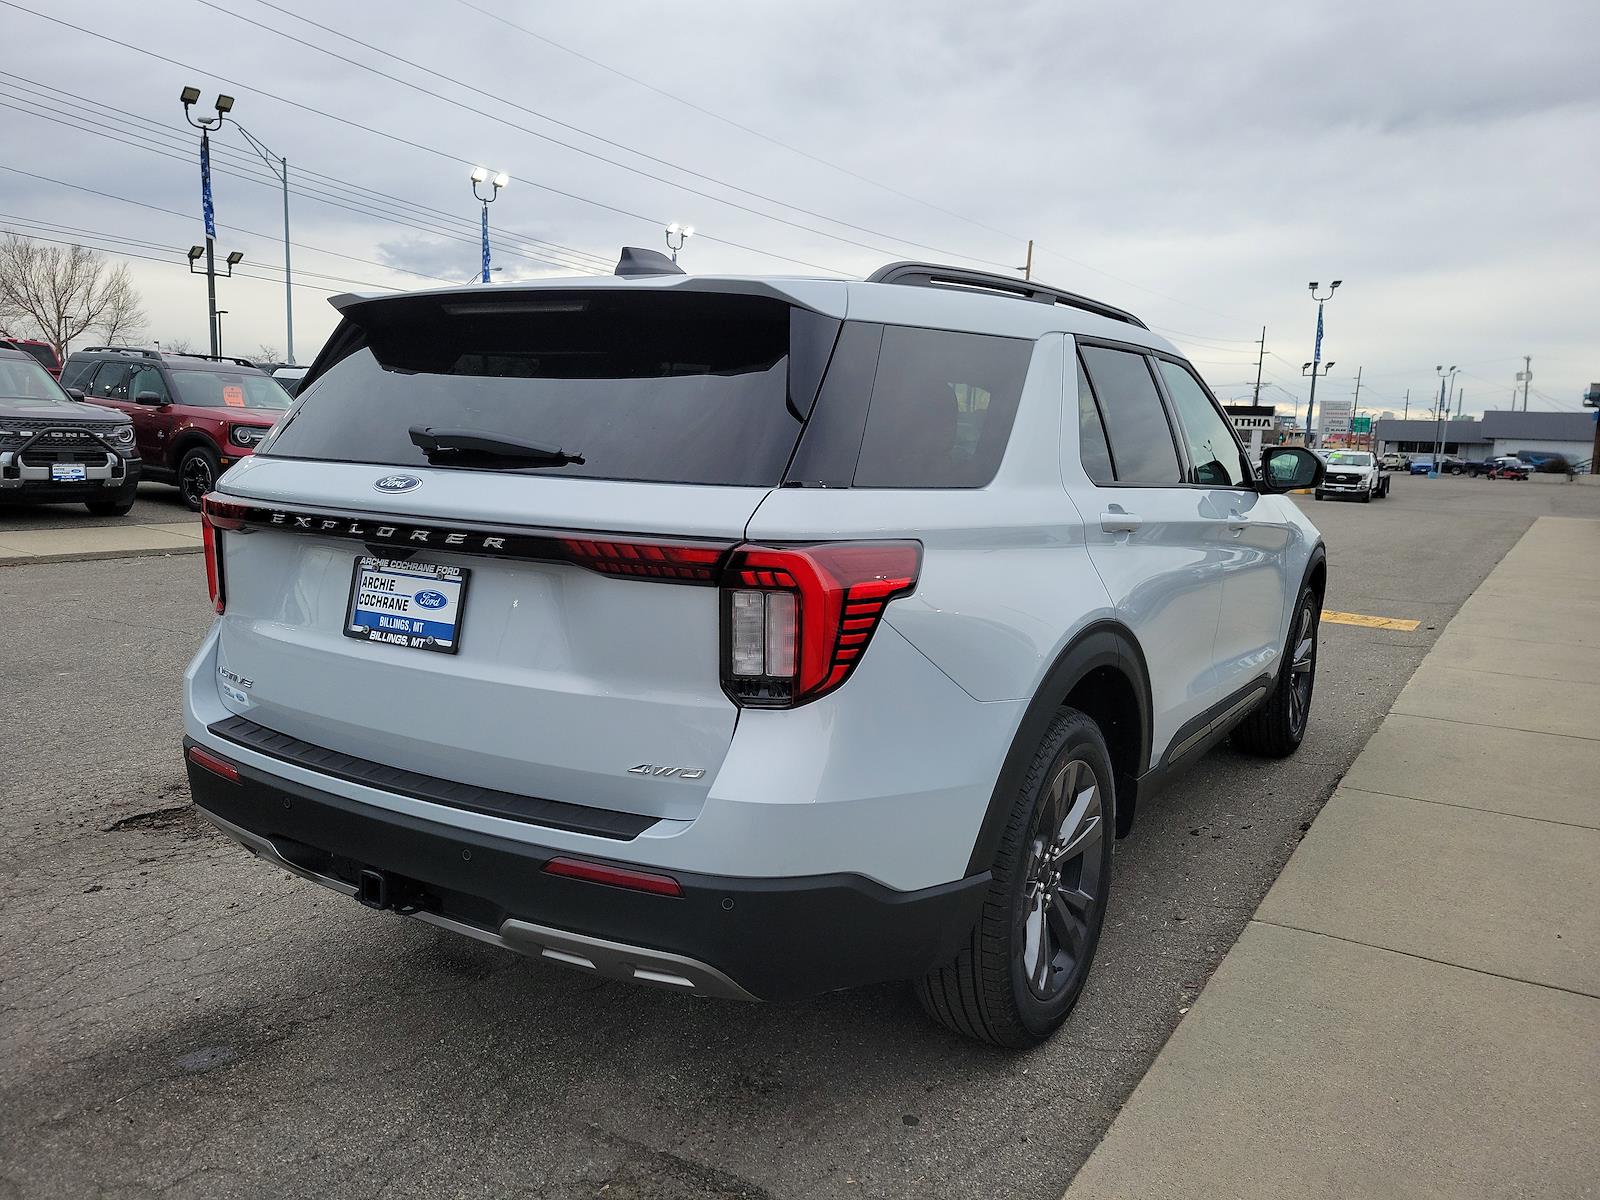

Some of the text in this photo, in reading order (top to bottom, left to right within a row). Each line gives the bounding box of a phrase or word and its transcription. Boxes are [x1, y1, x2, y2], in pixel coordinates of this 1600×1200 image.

[1230, 418, 1271, 427] ITHIA
[270, 513, 506, 549] EXPLORER
[360, 557, 460, 576] ARCHIE COCHRANE FORD
[362, 576, 395, 592] ARCHIE
[359, 593, 409, 611] COCHRANE
[379, 616, 424, 633] BILLINGS, MT
[369, 630, 426, 648] BILLINGS, MT
[627, 763, 706, 779] 4WD
